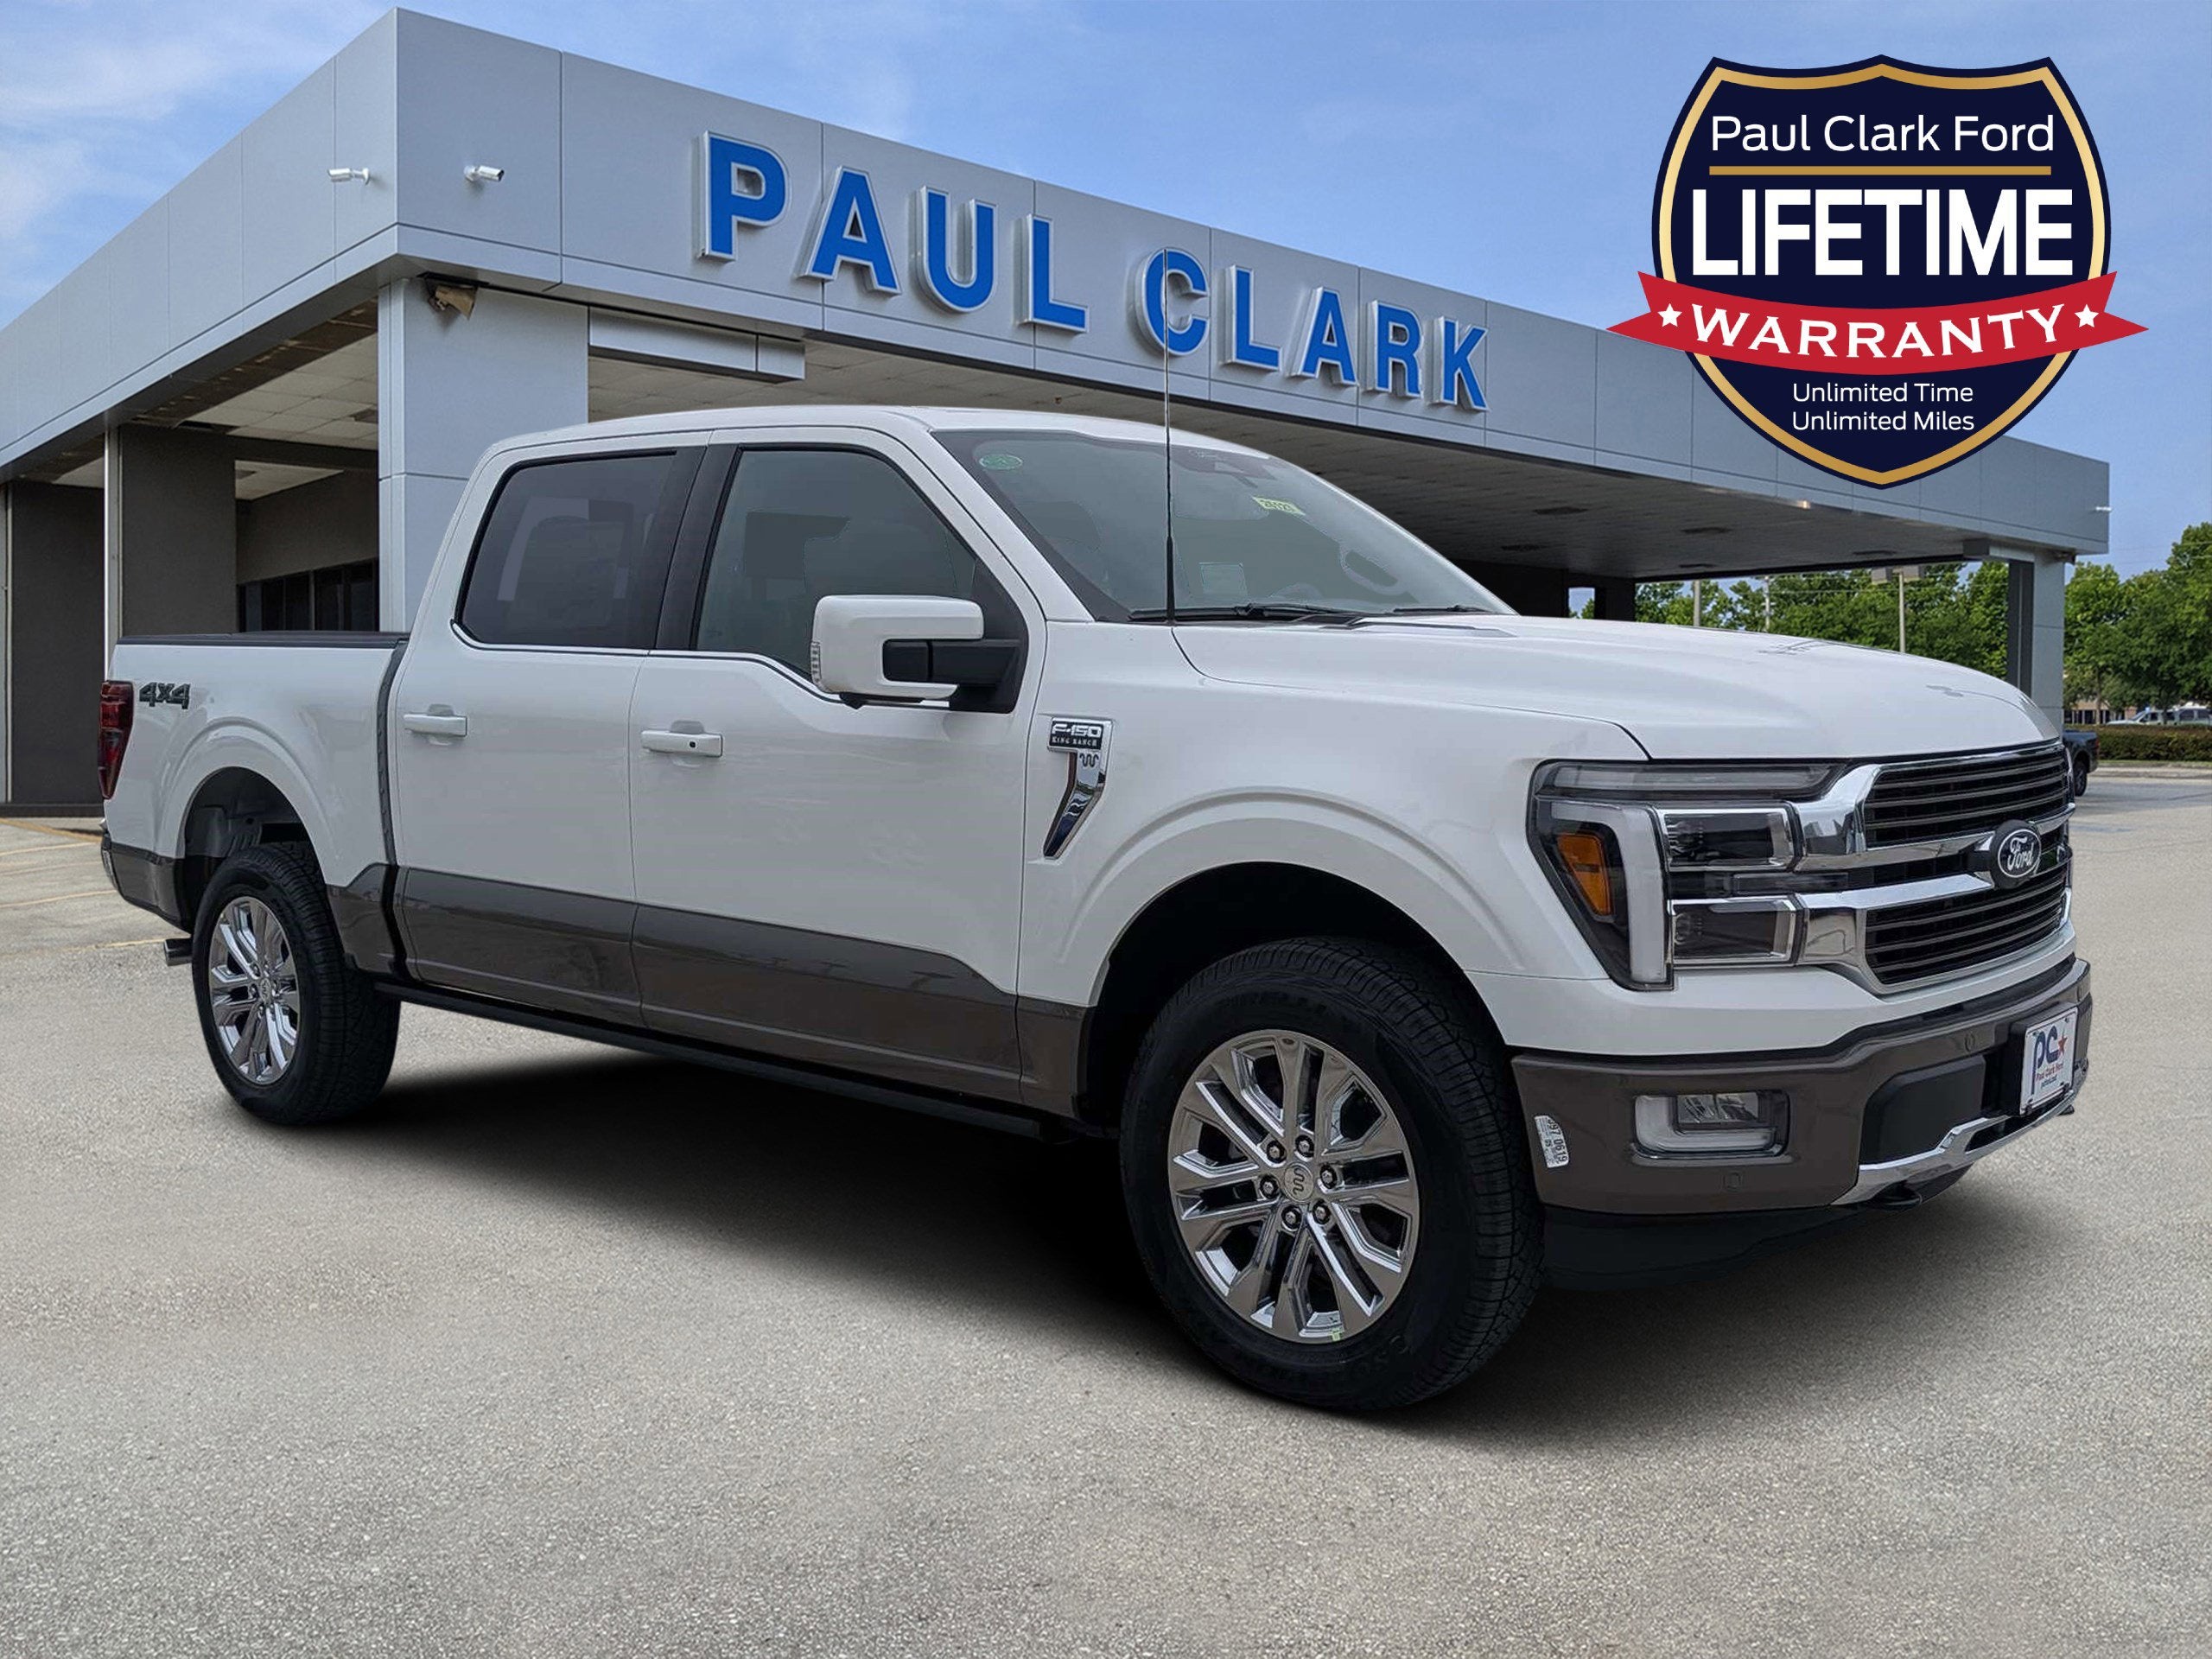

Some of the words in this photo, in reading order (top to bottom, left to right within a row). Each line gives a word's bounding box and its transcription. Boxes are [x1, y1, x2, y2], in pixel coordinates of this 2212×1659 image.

[697, 130, 1090, 334] PAUL
[1135, 246, 1489, 410] CLARK
[1052, 723, 1102, 738] F-150
[1052, 735, 1071, 745] KING
[1072, 738, 1098, 747] RANCH
[2007, 836, 2035, 871] Ford
[1553, 1139, 1568, 1162] 0619
